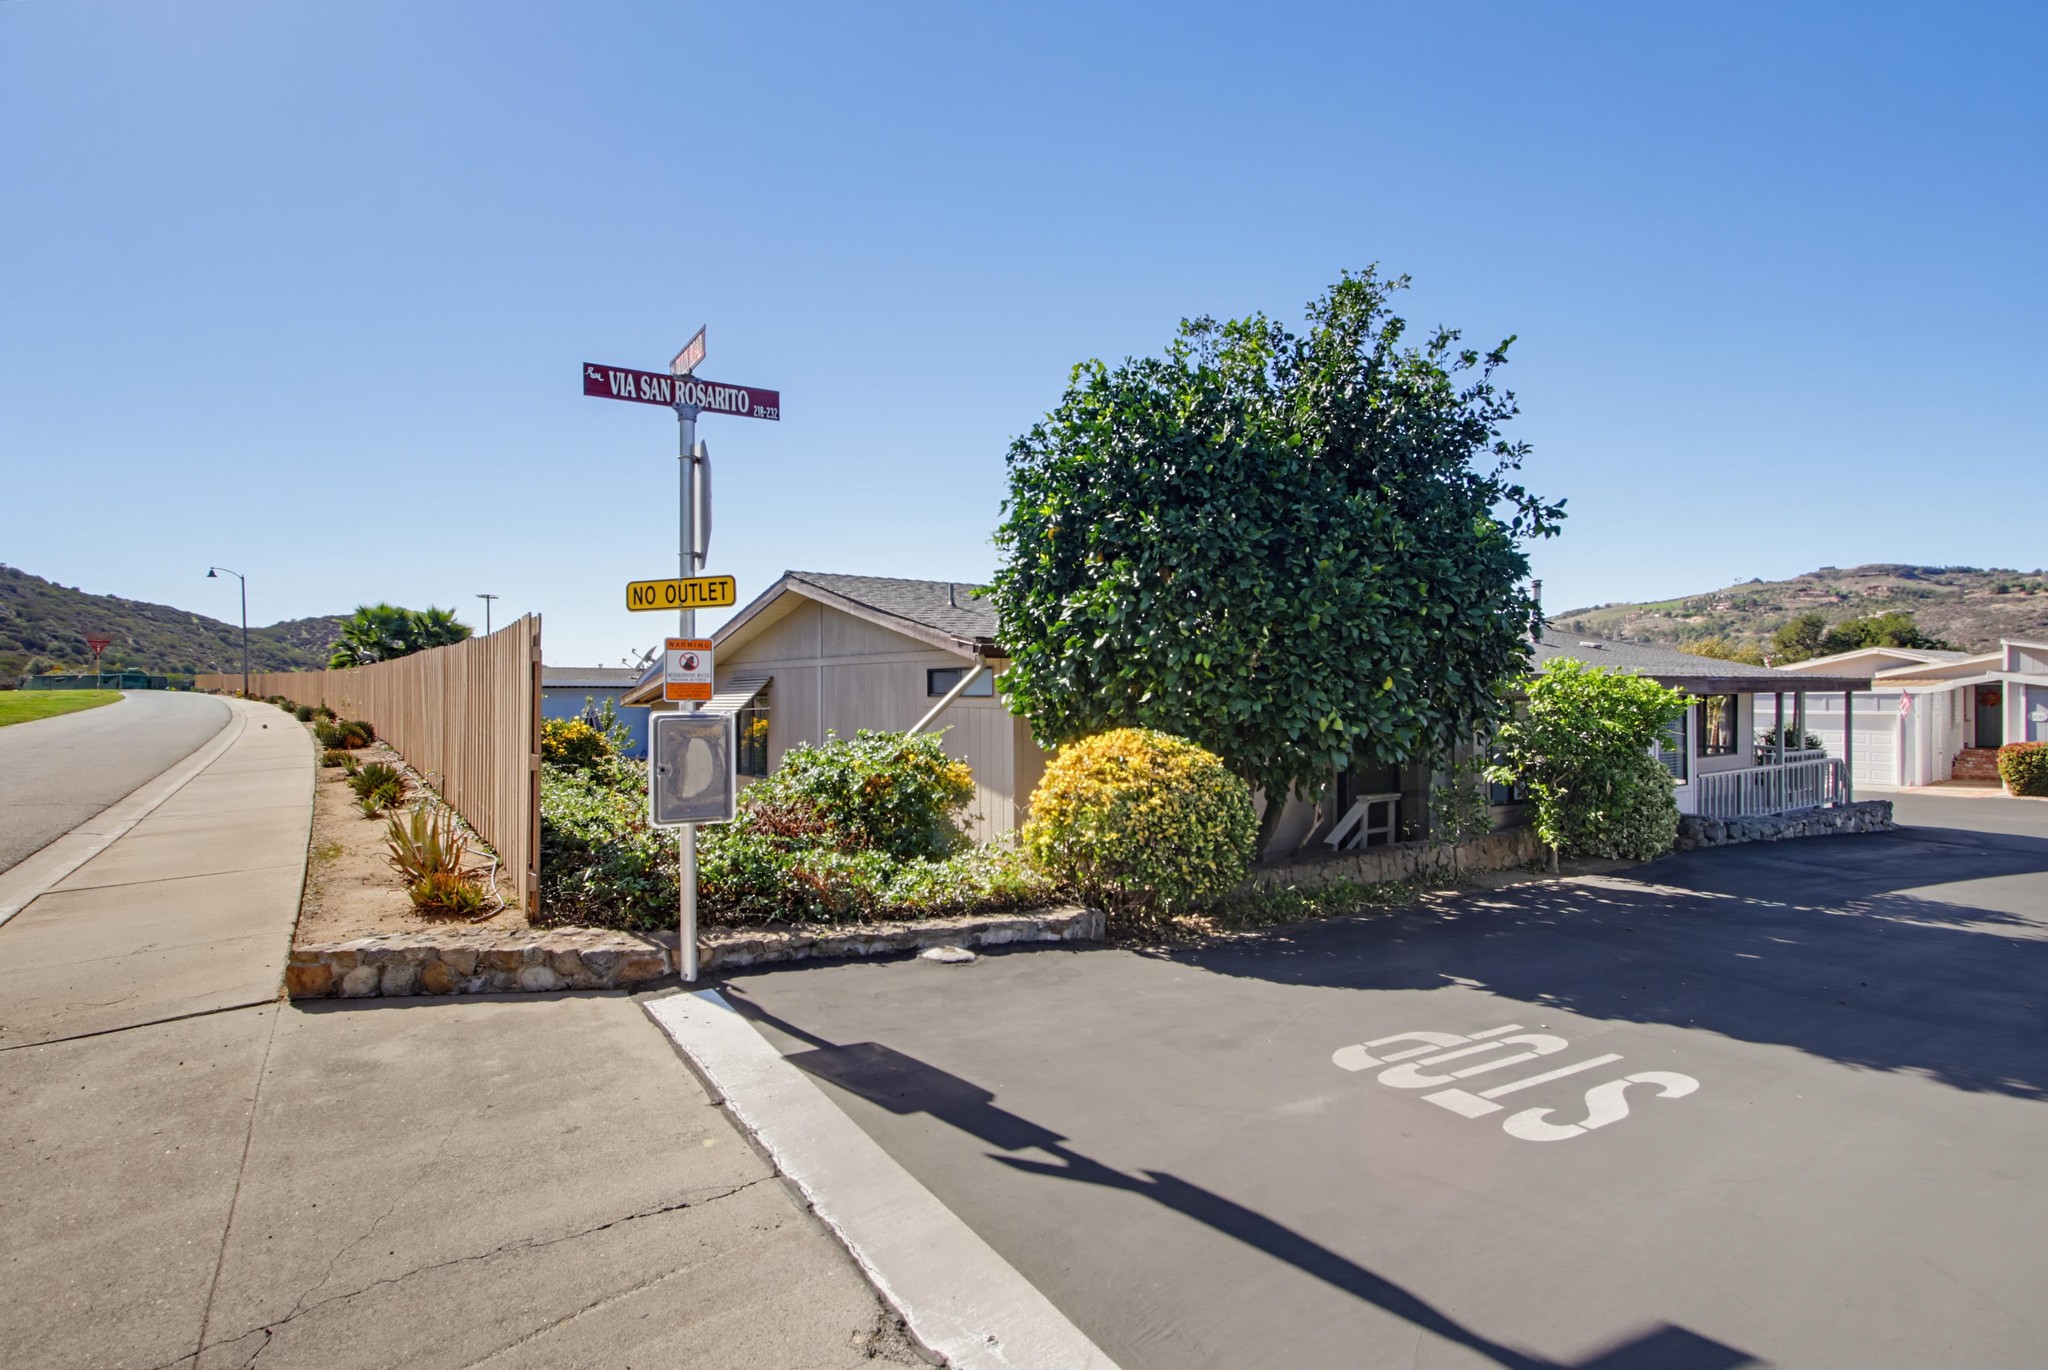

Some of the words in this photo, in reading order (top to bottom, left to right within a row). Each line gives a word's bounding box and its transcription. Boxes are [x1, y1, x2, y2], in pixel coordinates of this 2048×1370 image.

[608, 370, 637, 399] VIA
[640, 374, 671, 403] SAN
[674, 380, 750, 413] ROSARITO
[633, 585, 656, 605] NO
[665, 581, 728, 604] OUTLET
[668, 641, 710, 649] WARNING
[1331, 1023, 1700, 1142] STOP
